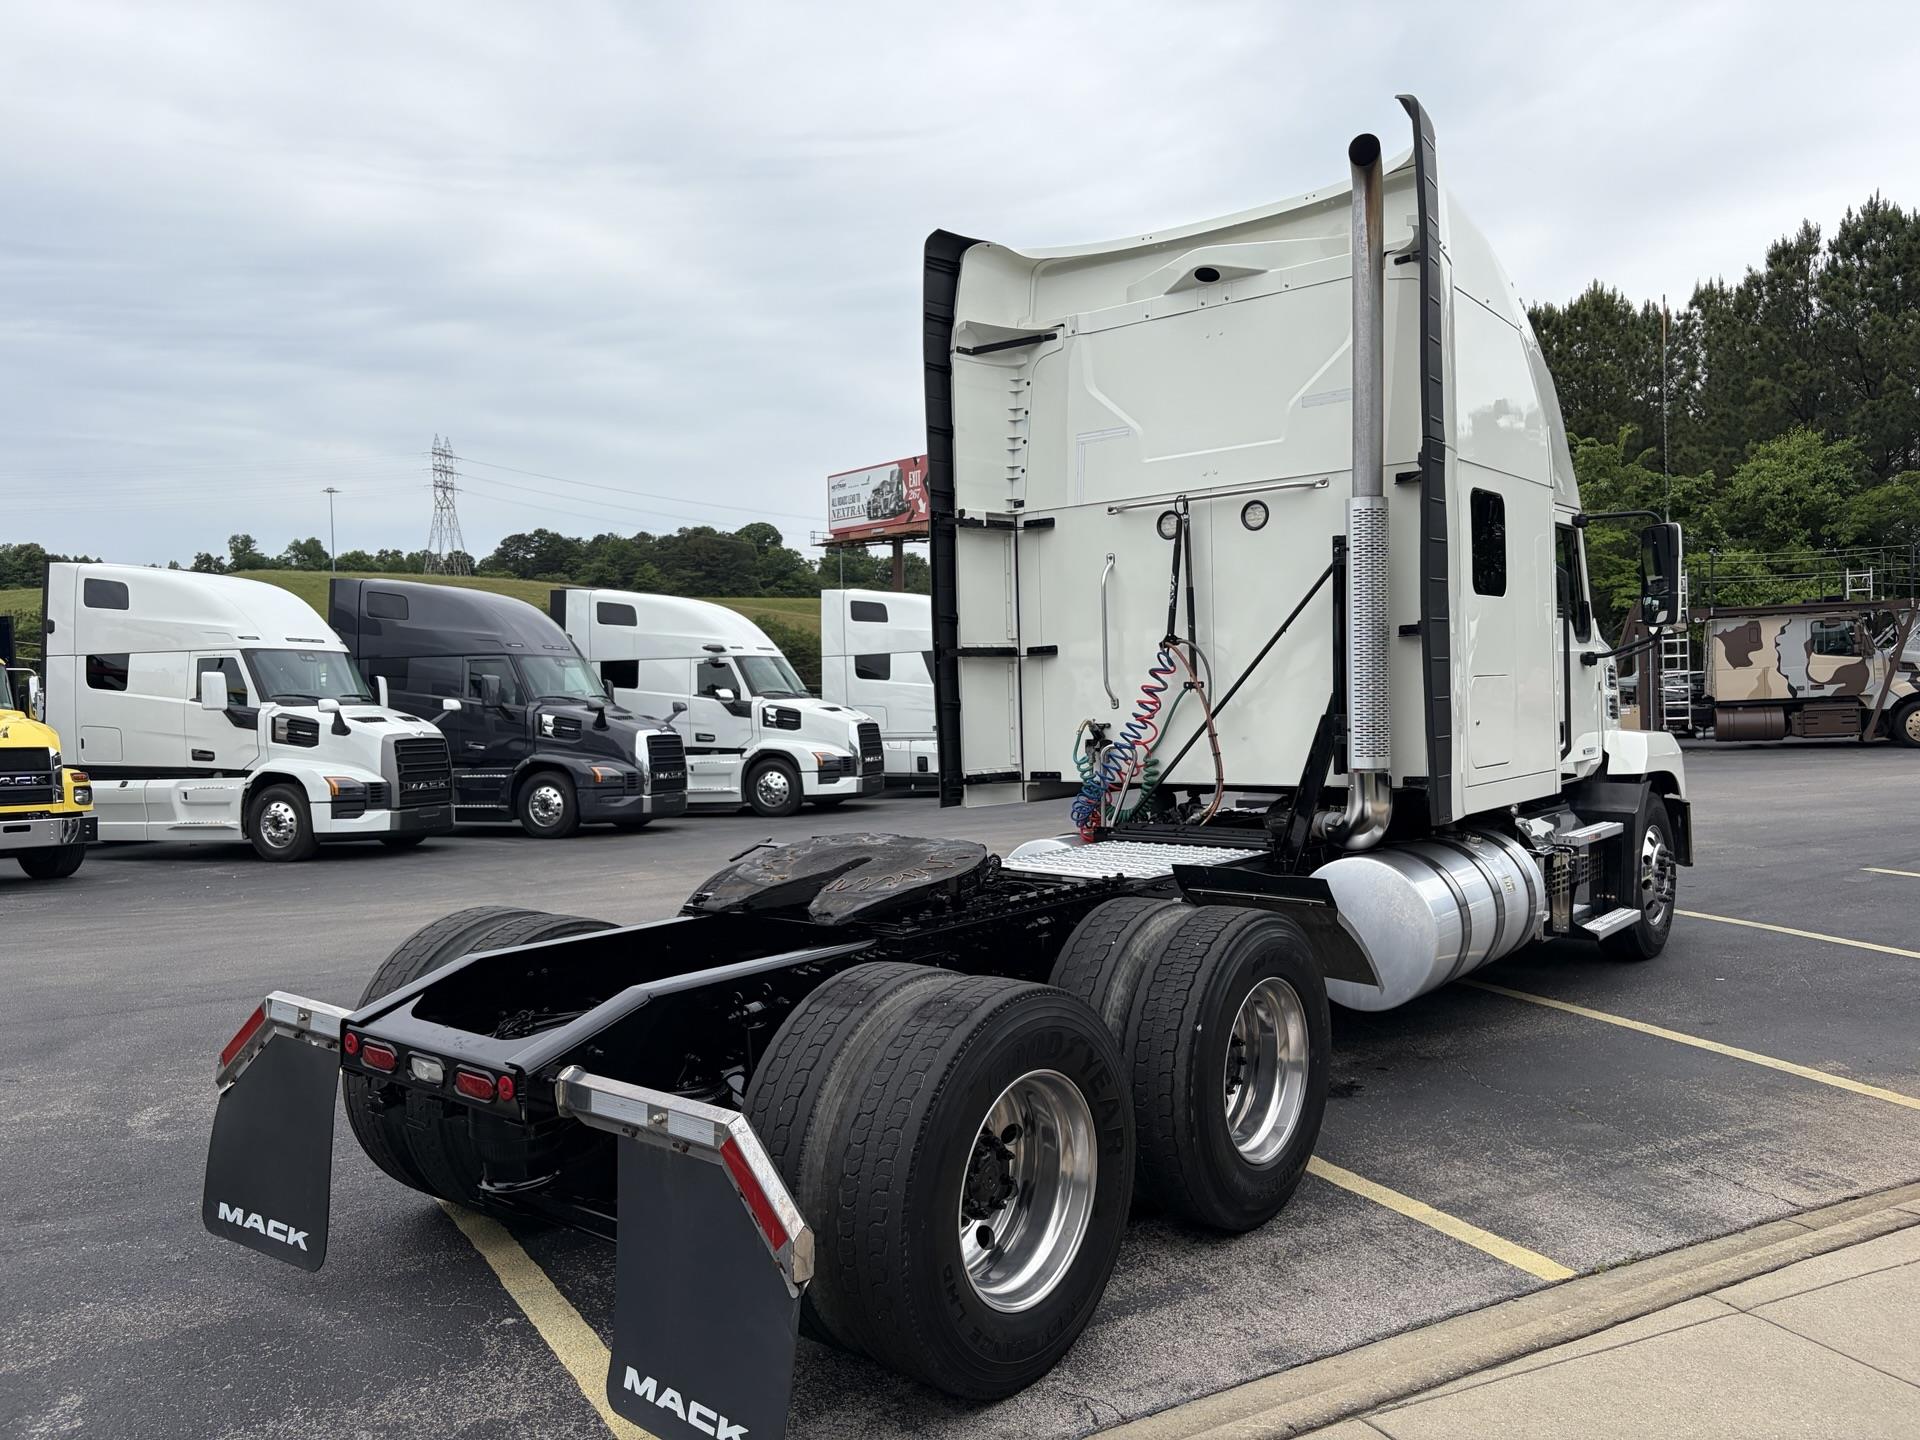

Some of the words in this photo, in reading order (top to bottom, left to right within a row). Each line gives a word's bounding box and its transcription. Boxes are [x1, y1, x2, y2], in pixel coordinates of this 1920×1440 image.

[909, 470, 921, 487] EXIT
[909, 488, 921, 500] 267
[832, 504, 866, 520] NEXTRAN
[218, 1201, 309, 1252] MACK
[623, 1365, 750, 1440] MACK
